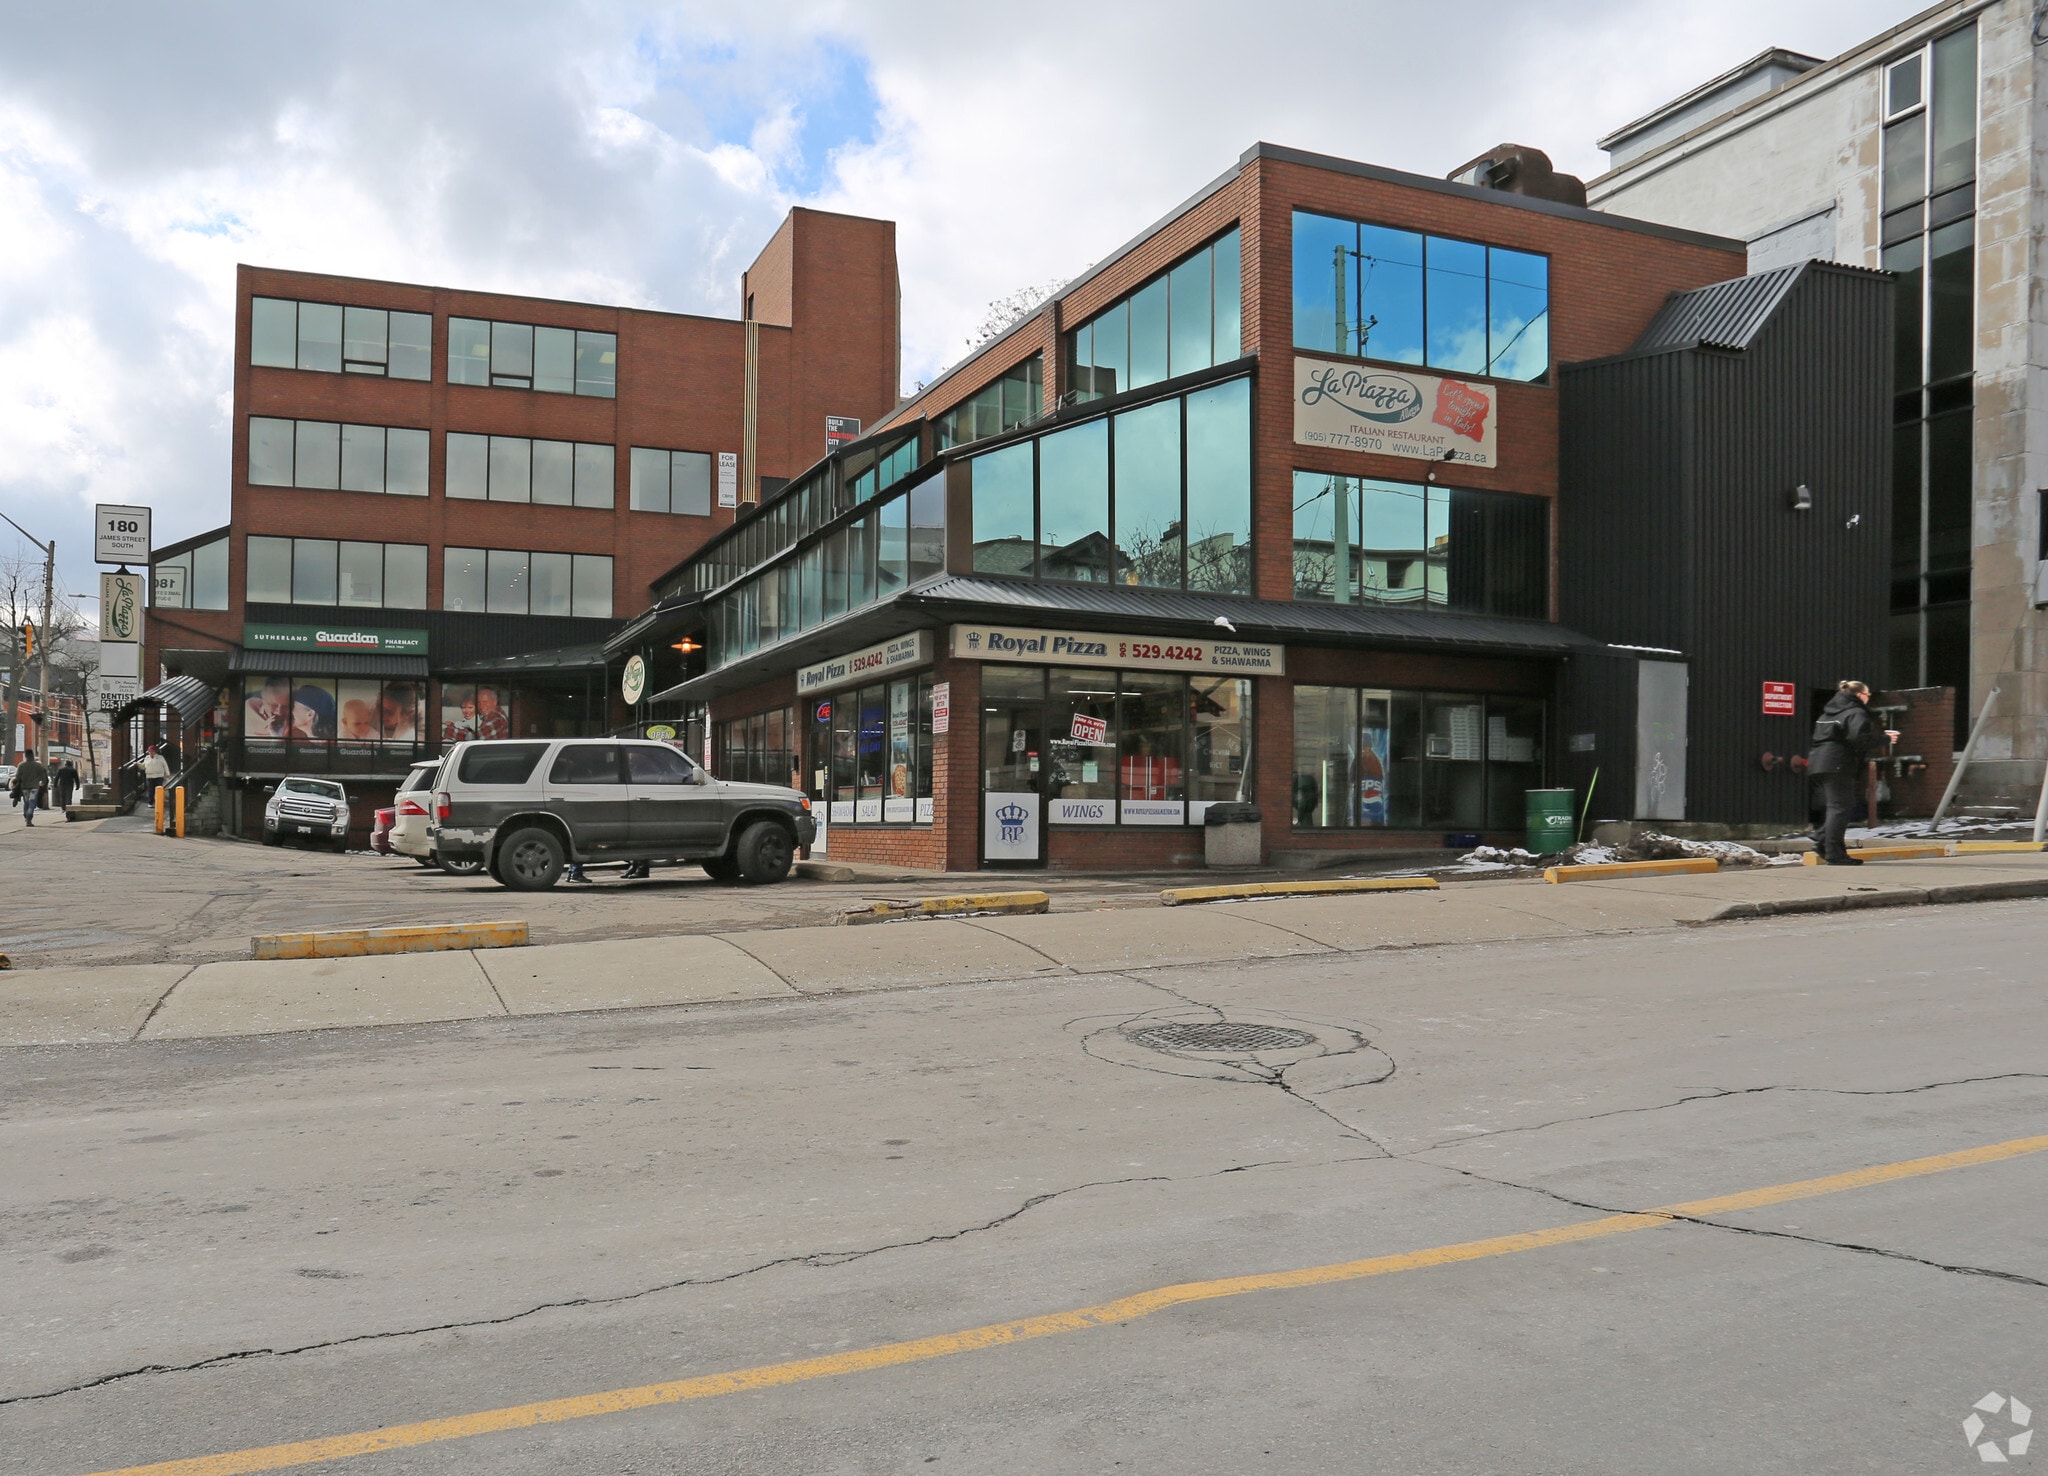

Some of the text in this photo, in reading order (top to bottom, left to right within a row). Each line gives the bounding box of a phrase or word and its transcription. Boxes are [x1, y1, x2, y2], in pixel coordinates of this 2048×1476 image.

[1302, 367, 1410, 410] La Piazza
[1442, 384, 1463, 400] Let's
[1448, 399, 1477, 418] tonight
[828, 418, 843, 426] BUILD
[1453, 416, 1477, 433] Italy!
[828, 438, 839, 446] CITY
[1350, 424, 1445, 445] ITALIAN RESTAURANT
[1304, 430, 1487, 464] (905) 777-8970 www.LaPizza.ca
[719, 461, 735, 469] LEASE
[107, 519, 138, 533] 180
[99, 534, 146, 543] JAMES STREET
[115, 577, 134, 598] La
[117, 597, 134, 632] Piazza
[254, 634, 308, 642] SUTHERLAND
[315, 631, 379, 644] Guardian
[887, 638, 915, 654] PIZZA, WINGS
[988, 632, 1203, 661] Royal Pizza 905 529.4242
[1214, 645, 1271, 657] PIZZA, WINGS
[890, 649, 915, 665] SHAWARMA
[1211, 656, 1271, 667] & SHAWARMA
[806, 666, 825, 688] Royal
[826, 664, 845, 681] Pizza
[854, 651, 883, 672] 529.4242
[100, 692, 135, 700] DENTIST
[650, 730, 672, 739] OPEN
[1073, 723, 1103, 742] OPEN
[247, 746, 286, 754] Guardian
[861, 804, 877, 817] SALAD
[1062, 805, 1104, 819] WINGS
[1001, 826, 1024, 844] RP
